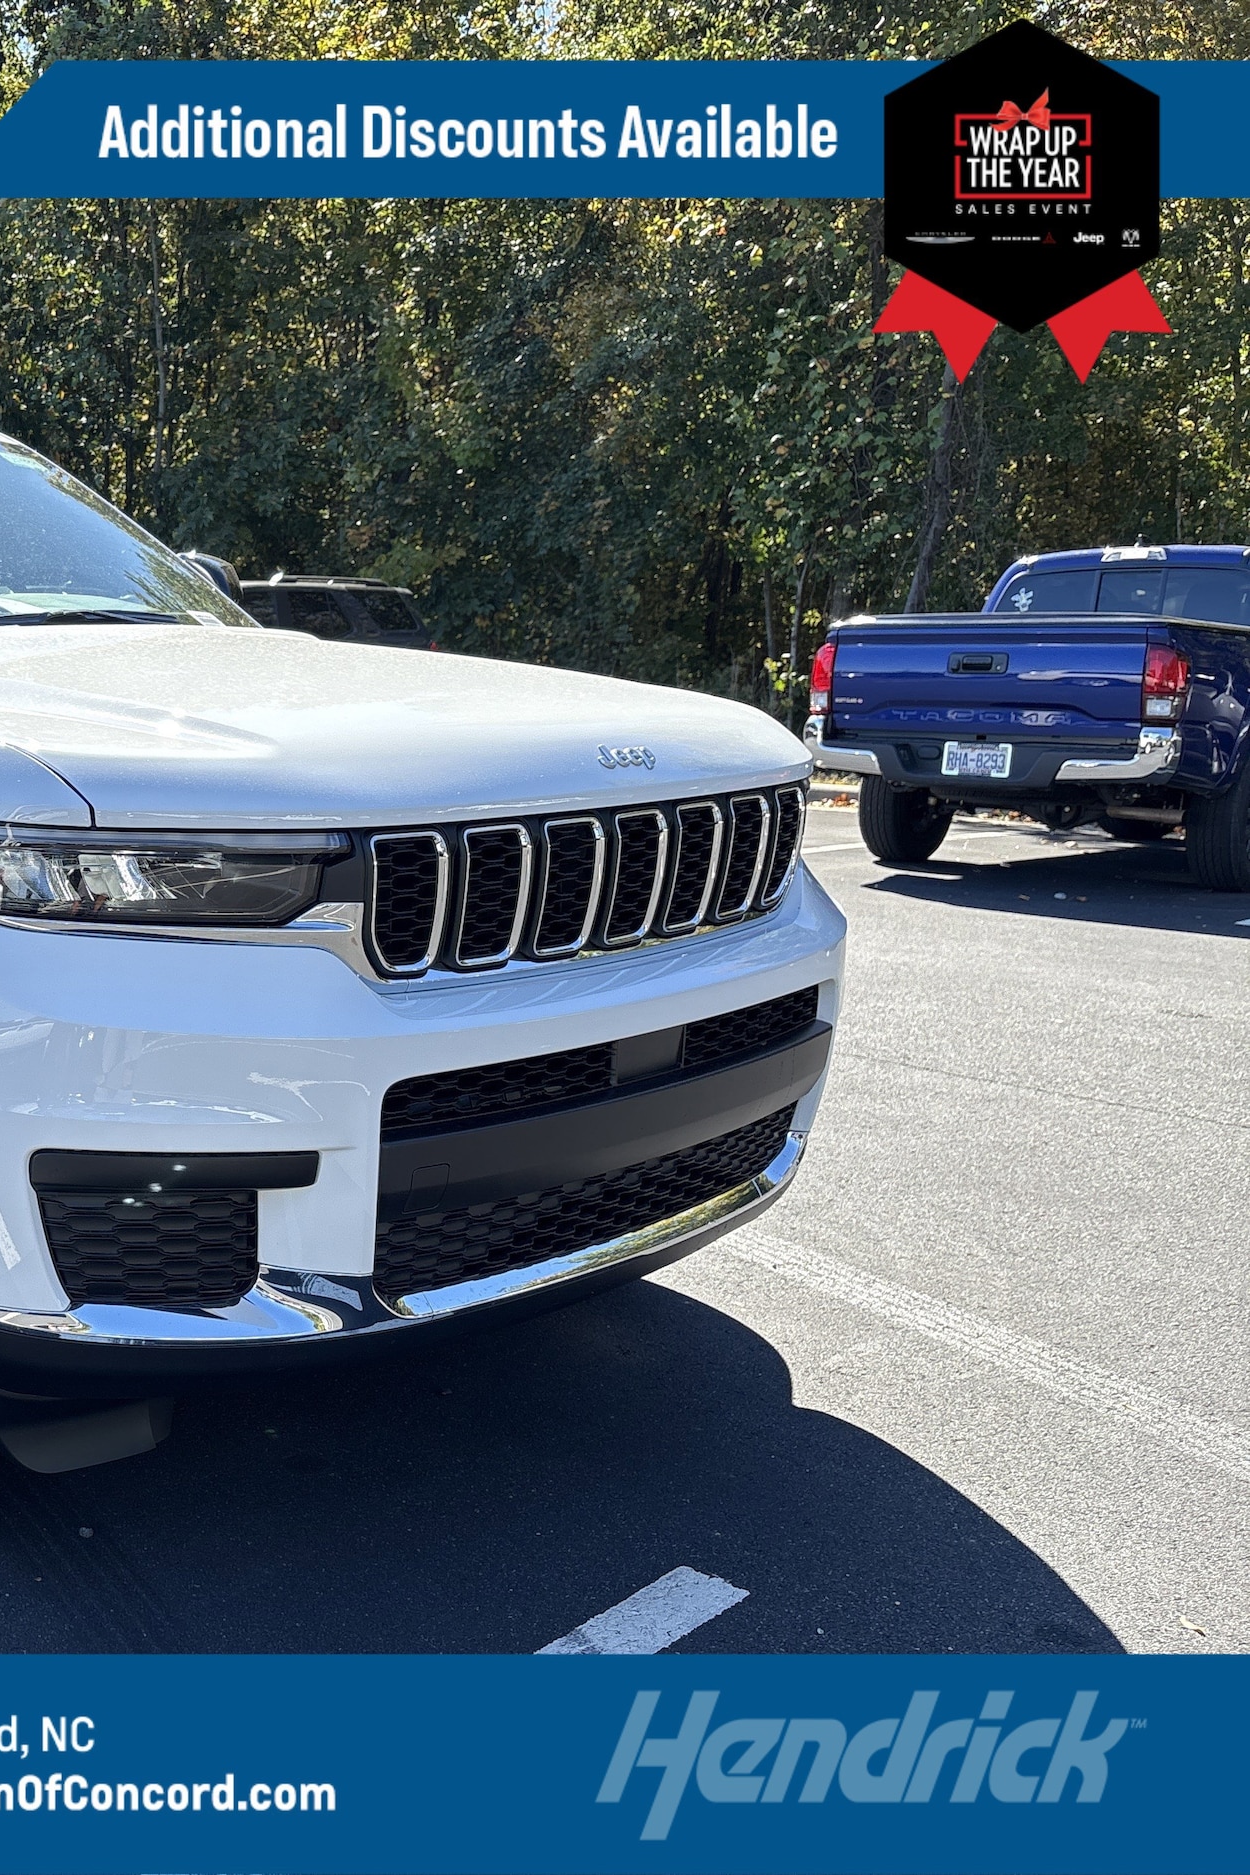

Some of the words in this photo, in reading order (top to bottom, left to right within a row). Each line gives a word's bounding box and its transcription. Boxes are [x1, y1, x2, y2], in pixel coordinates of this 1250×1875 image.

[892, 708, 1072, 726] TACOMA
[597, 743, 657, 770] Jeep
[947, 751, 1006, 770] RHA-8293
